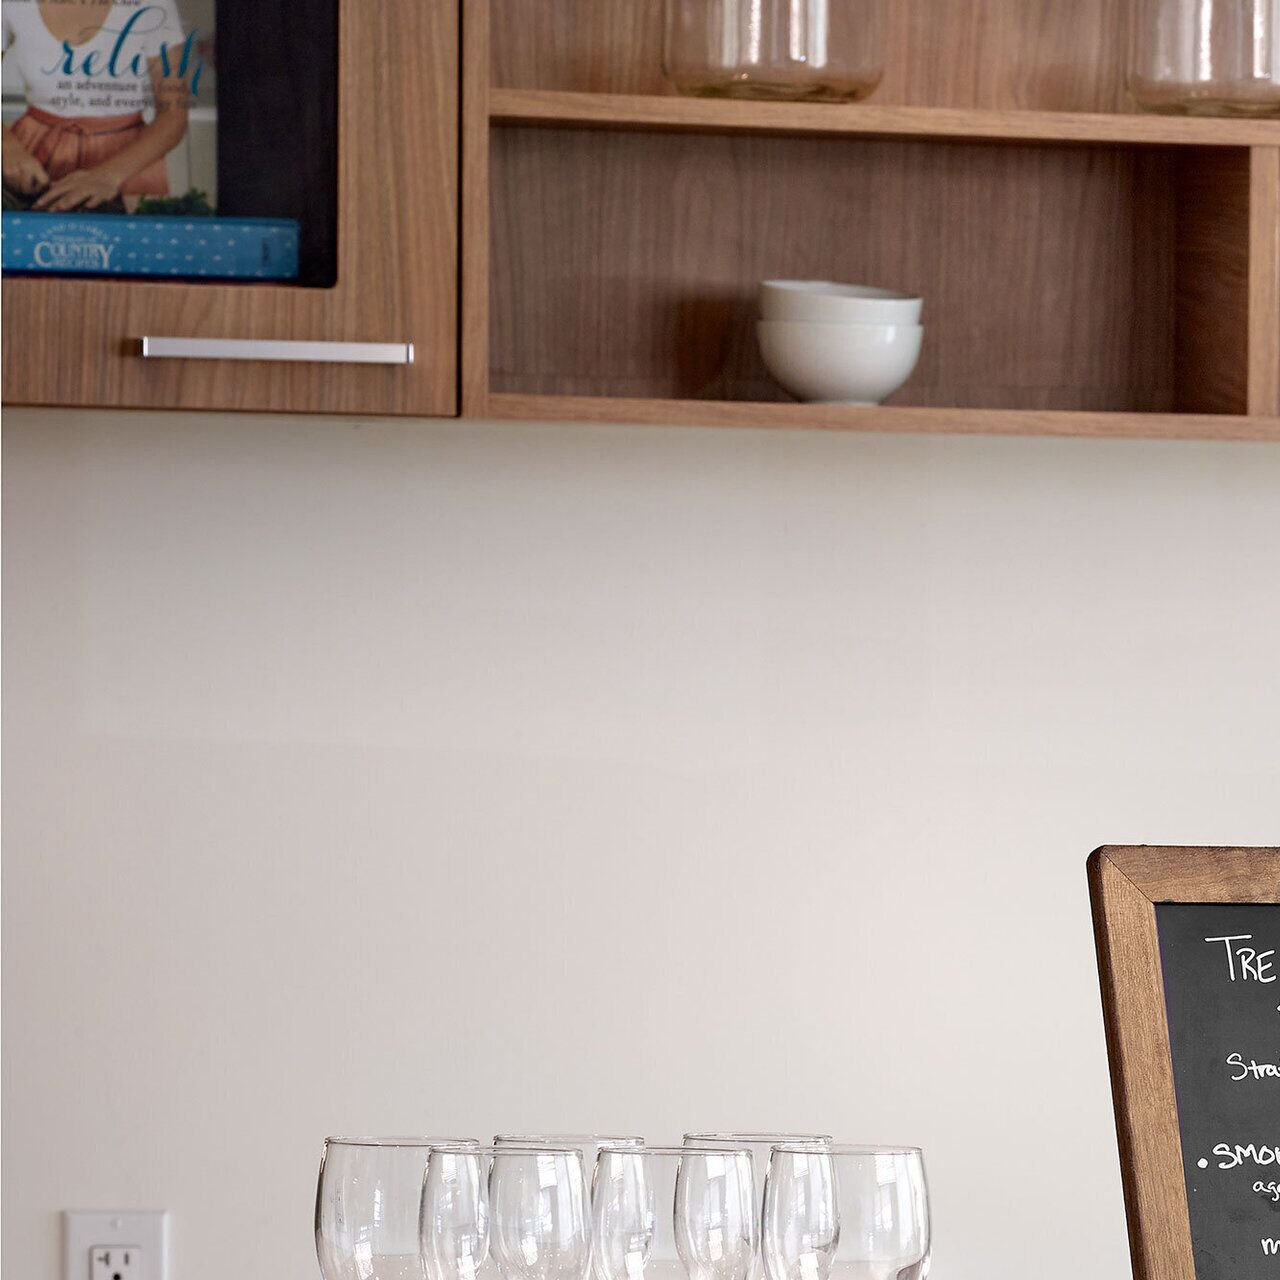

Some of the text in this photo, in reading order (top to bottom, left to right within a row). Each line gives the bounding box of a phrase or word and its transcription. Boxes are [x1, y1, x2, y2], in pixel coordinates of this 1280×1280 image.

[41, 6, 205, 96] relish
[88, 95, 111, 107] and
[33, 240, 114, 270] COUNTRY
[1204, 934, 1278, 983] TRE
